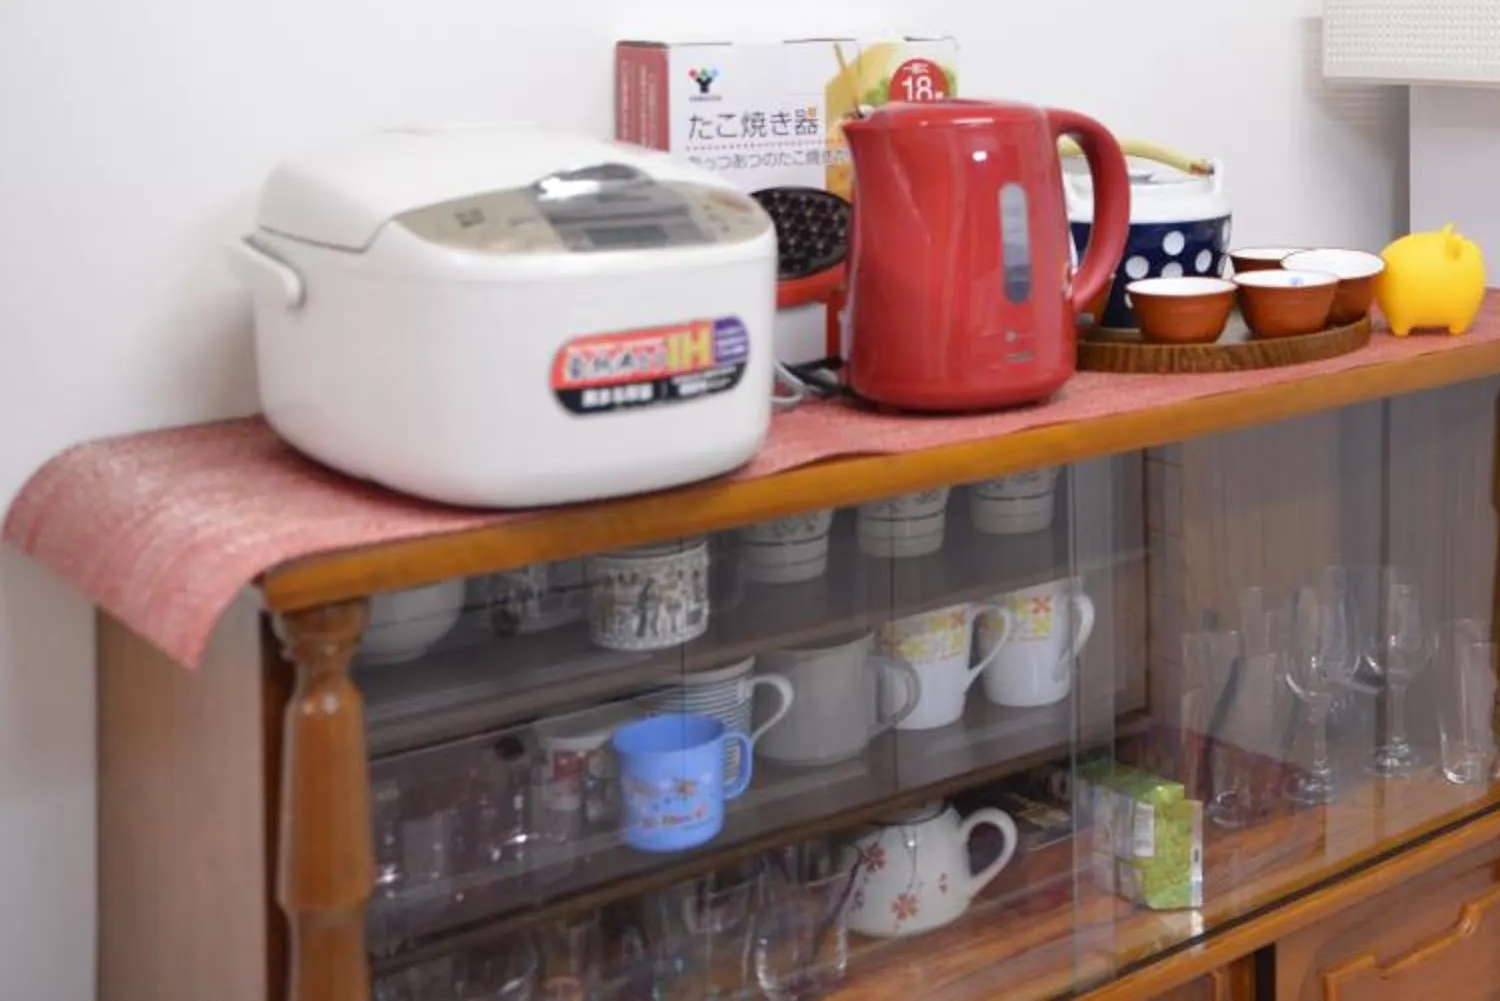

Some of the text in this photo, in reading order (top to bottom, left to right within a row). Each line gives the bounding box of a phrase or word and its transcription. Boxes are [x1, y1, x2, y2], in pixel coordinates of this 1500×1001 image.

[688, 106, 818, 140] たこ焼き器
